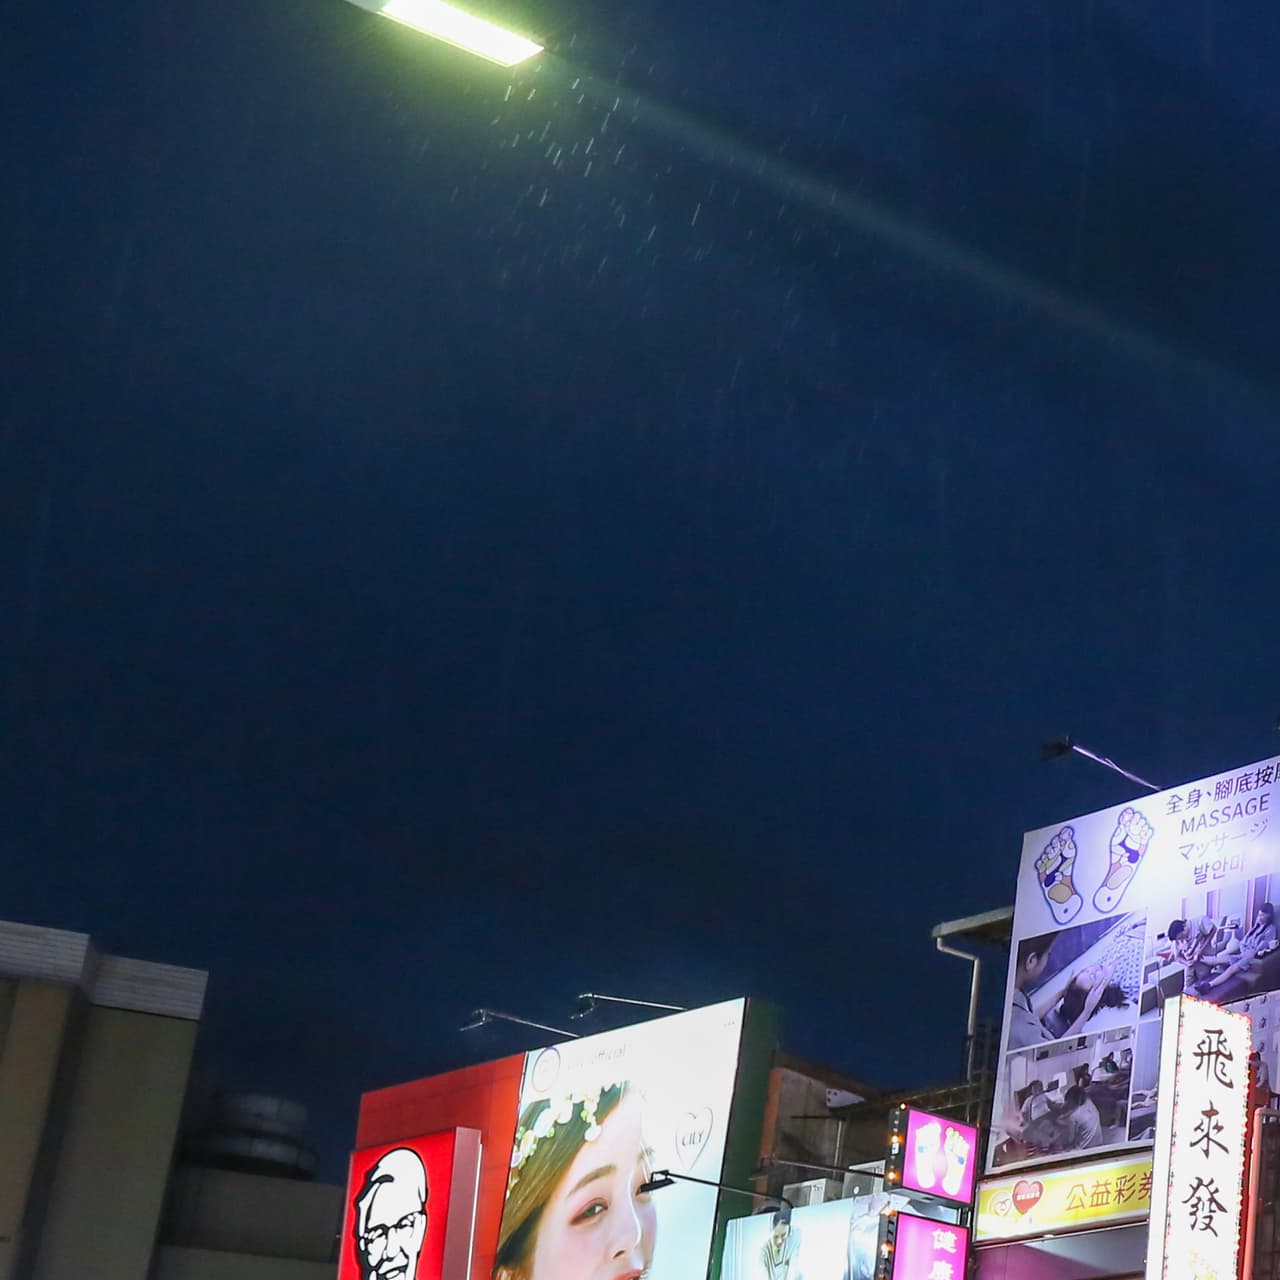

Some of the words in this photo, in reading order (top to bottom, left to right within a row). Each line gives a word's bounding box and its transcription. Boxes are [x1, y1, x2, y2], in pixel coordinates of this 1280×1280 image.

[1181, 793, 1271, 837] MASSAGE
[1178, 819, 1269, 862] マッサージ
[1193, 852, 1248, 886] 발안마
[1181, 1028, 1235, 1238] 飛來發
